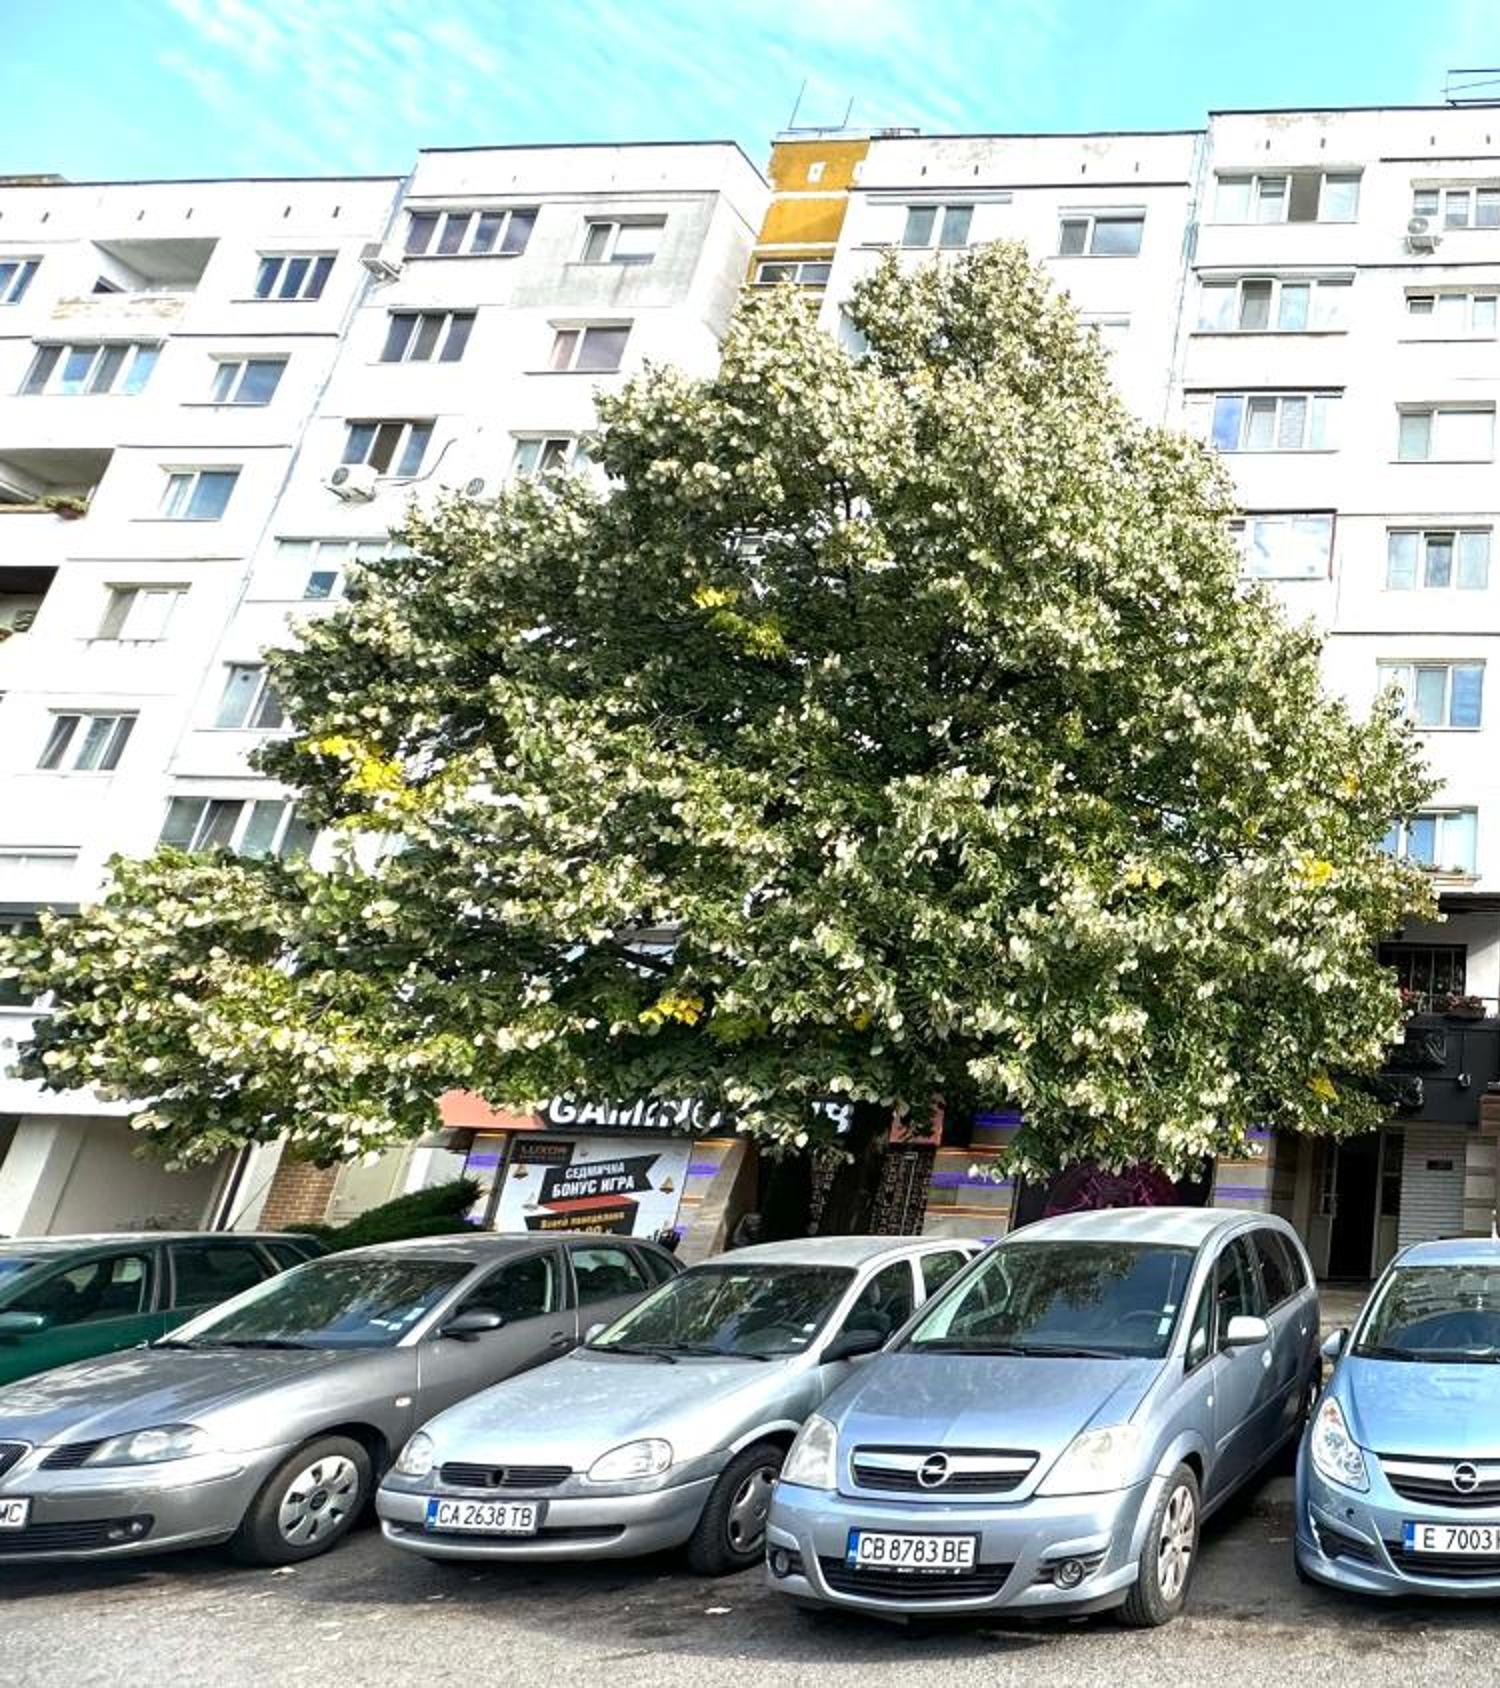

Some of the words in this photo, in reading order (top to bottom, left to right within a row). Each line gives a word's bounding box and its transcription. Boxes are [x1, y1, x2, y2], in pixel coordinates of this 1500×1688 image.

[565, 1162, 625, 1179] СЕДМИЧНА
[552, 1180, 598, 1198] БОНУС
[601, 1175, 635, 1192] ИГРА
[439, 1503, 460, 1524] CA
[463, 1505, 507, 1526] 2638
[511, 1507, 533, 1527] TB
[861, 1537, 886, 1560] CB
[889, 1539, 939, 1562] 8783
[941, 1540, 971, 1562] BE
[1423, 1527, 1435, 1549] E
[1446, 1529, 1493, 1550] 7003
